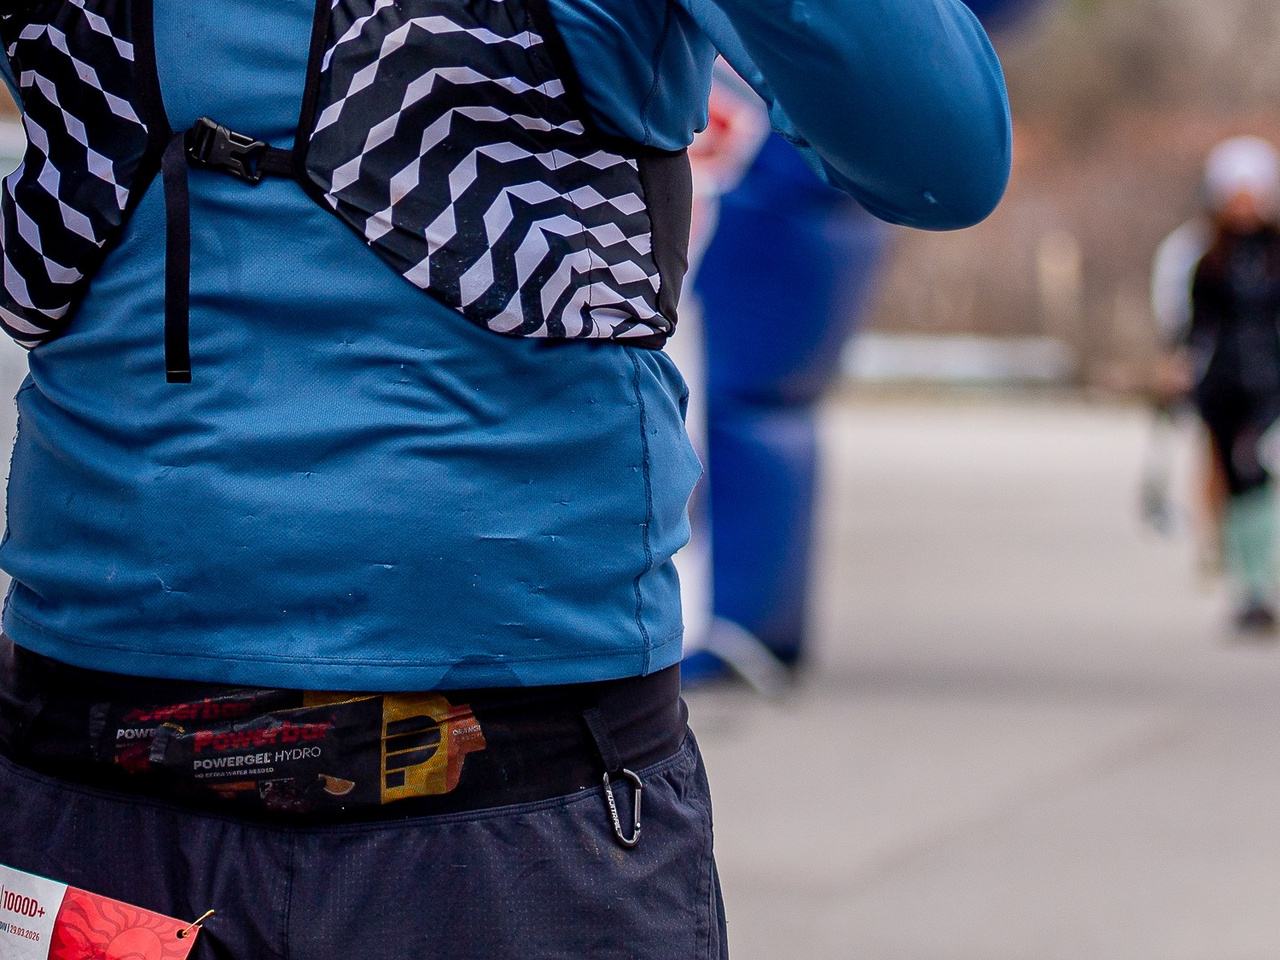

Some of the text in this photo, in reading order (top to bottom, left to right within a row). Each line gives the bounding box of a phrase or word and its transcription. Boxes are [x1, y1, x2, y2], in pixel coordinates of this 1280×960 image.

[274, 746, 322, 763] HYDRO
[3, 890, 46, 918] 1000D+
[9, 924, 41, 942] 29.03.2026
